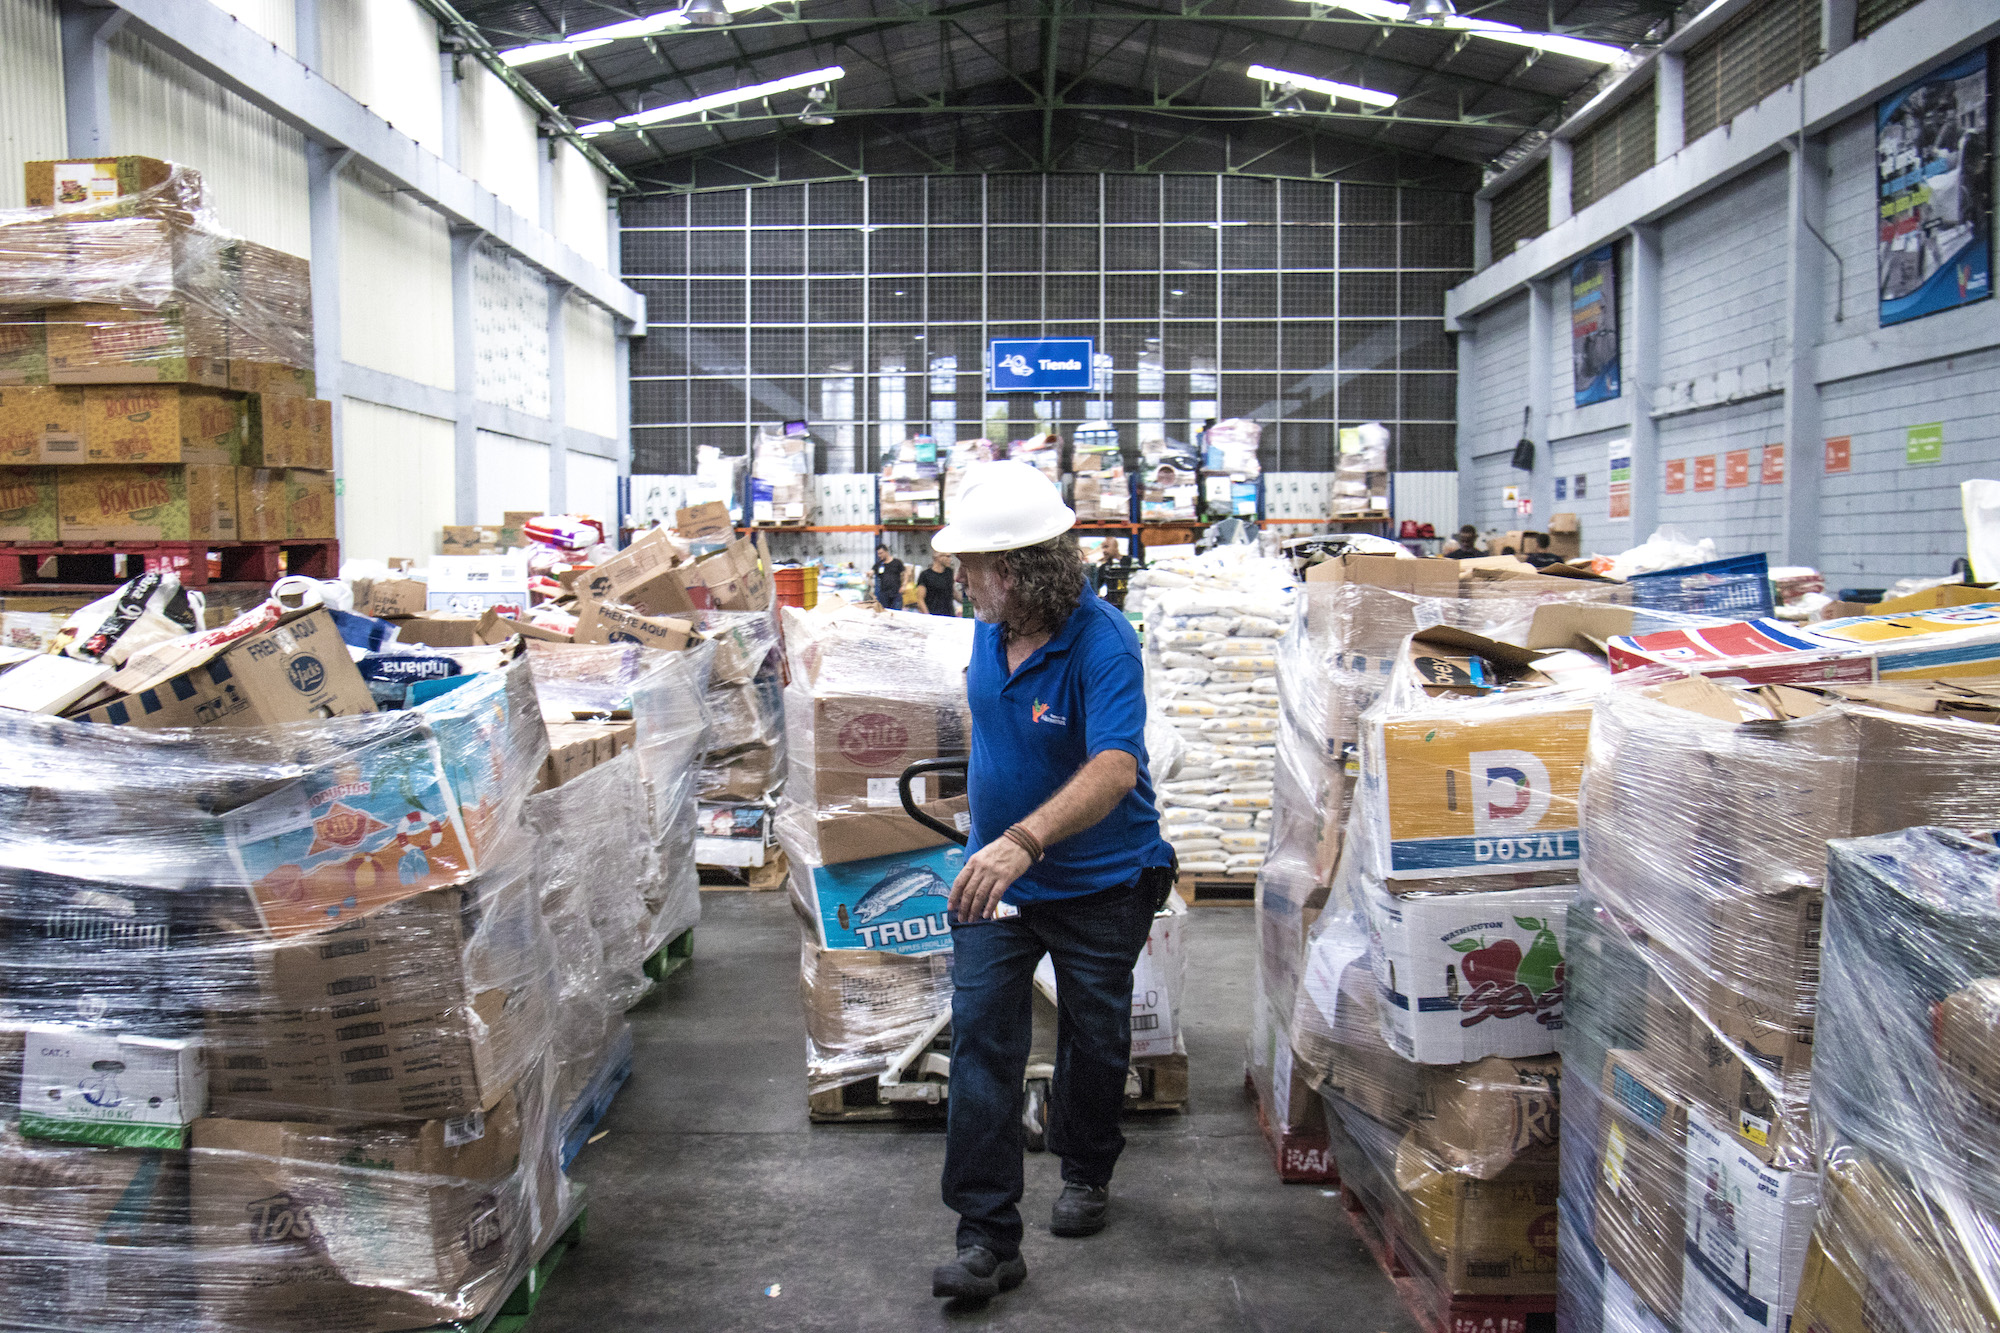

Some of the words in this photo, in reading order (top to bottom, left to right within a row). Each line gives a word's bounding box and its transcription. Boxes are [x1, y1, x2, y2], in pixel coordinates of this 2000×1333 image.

[1038, 359, 1082, 370] Tienda
[0, 485, 38, 512] ITAS
[598, 606, 639, 629] FRENTE
[380, 660, 449, 679] Indiana
[309, 782, 371, 807] ODUCTOS
[1474, 835, 1573, 862] DOSAL
[854, 911, 952, 950] TROU
[1440, 921, 1504, 943] WASHINGTON
[898, 943, 920, 953] APPLES
[940, 937, 953, 947] LAK
